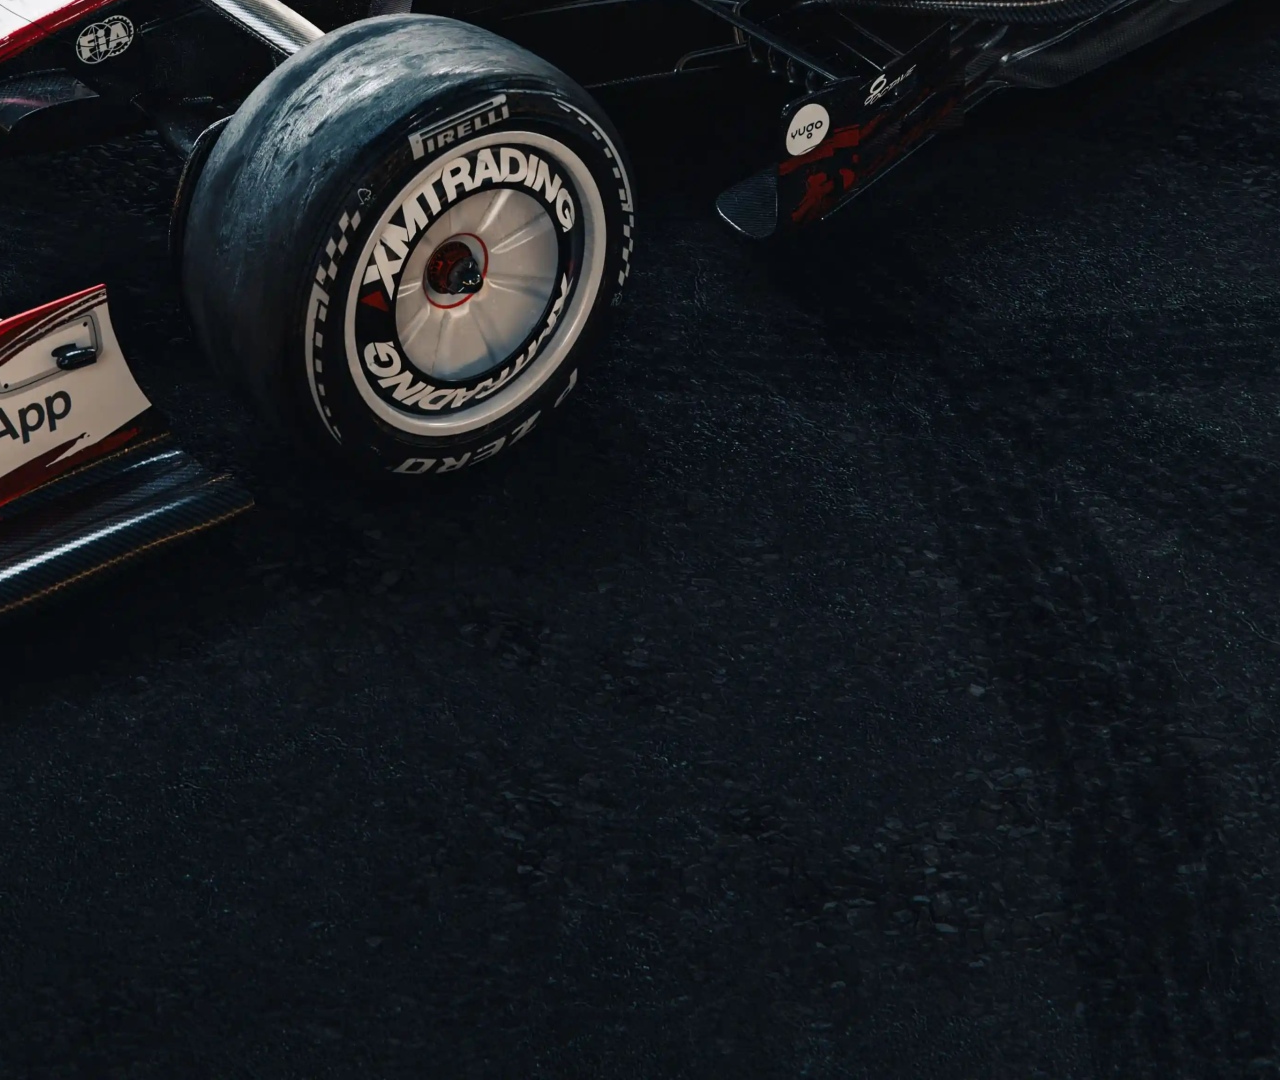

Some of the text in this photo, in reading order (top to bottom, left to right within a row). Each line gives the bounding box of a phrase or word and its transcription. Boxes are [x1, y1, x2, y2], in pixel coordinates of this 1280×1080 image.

[408, 94, 510, 161] PIRELLI
[790, 120, 824, 140] yugo
[363, 147, 576, 301] XMTRADING
